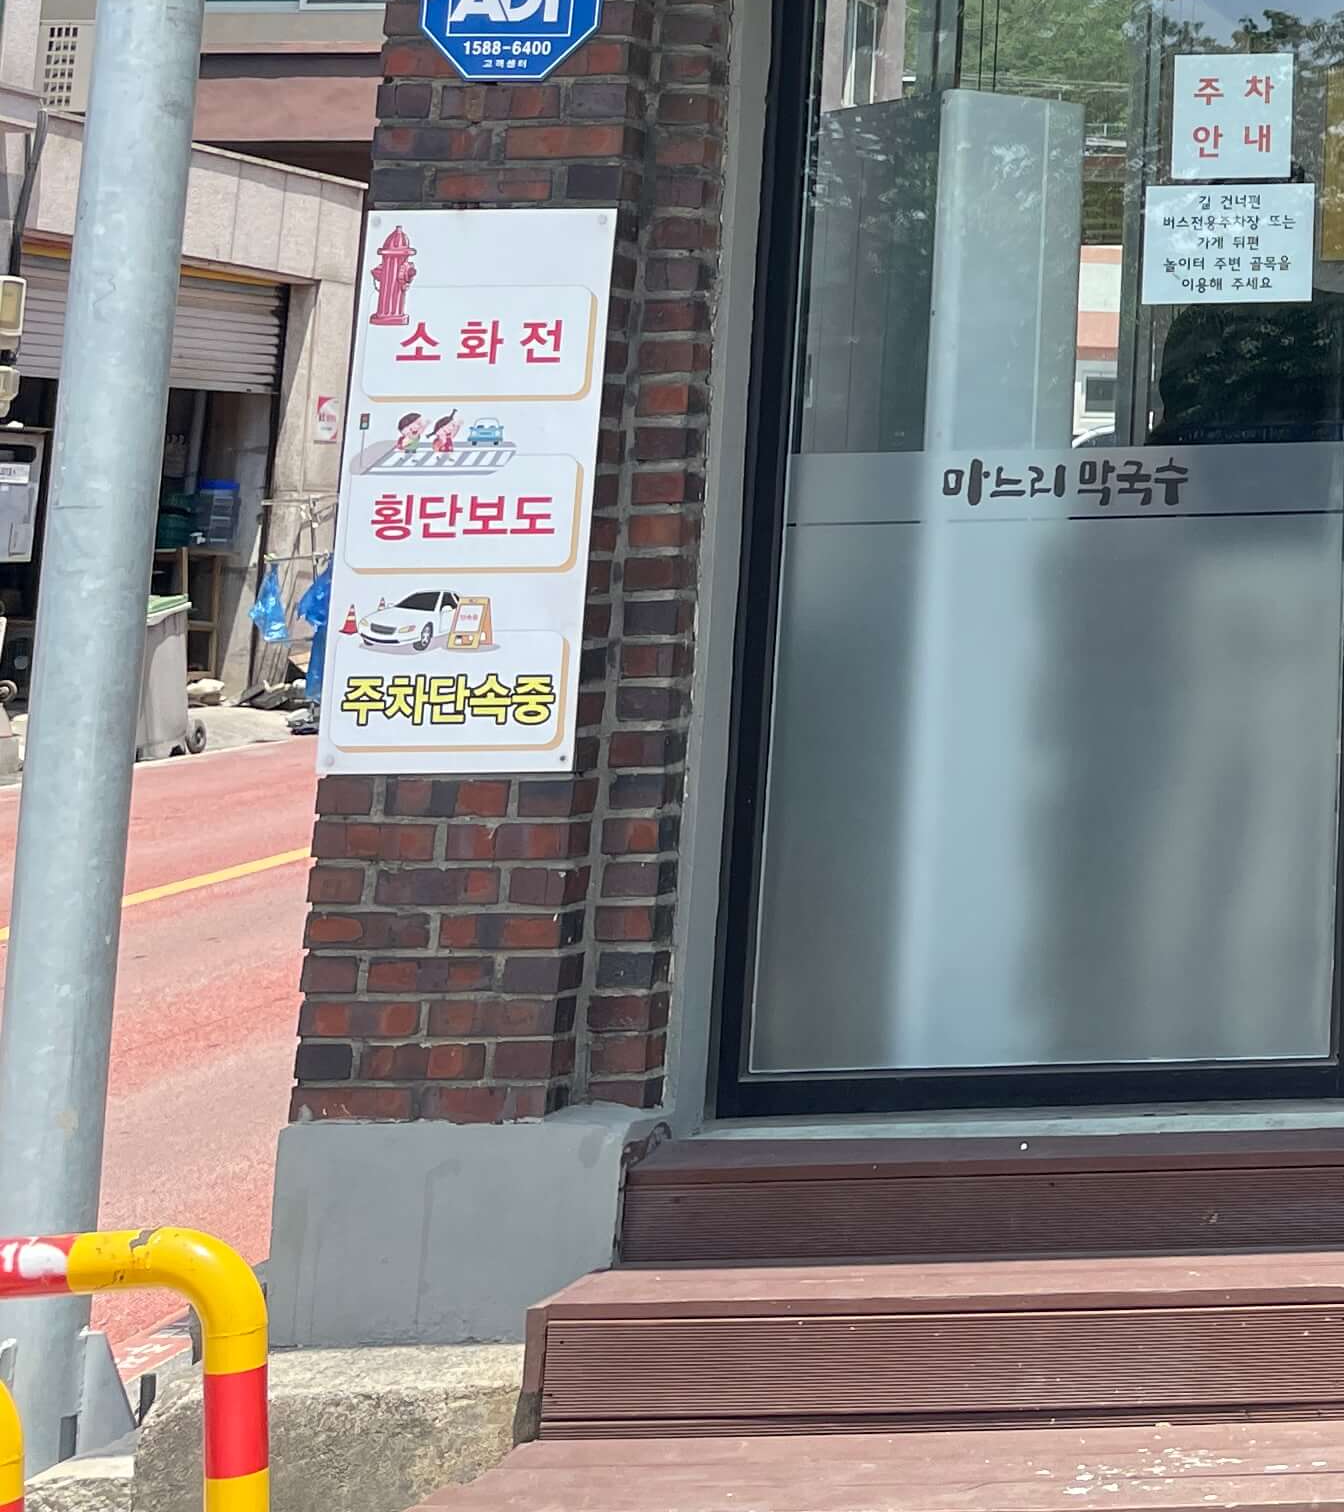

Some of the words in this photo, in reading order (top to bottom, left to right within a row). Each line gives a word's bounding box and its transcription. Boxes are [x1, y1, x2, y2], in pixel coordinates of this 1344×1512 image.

[463, 40, 552, 56] 1588-6400
[1199, 195, 1211, 210] 길
[1220, 194, 1262, 210] 건너편
[1163, 215, 1260, 232] 버스전용주차장
[1268, 215, 1297, 230] 또는
[1197, 236, 1224, 250] 가게
[1233, 236, 1260, 251] 뒤편
[1163, 257, 1206, 273] 놀이터
[1214, 257, 1242, 271] 주변
[1250, 255, 1292, 271] 골목을
[1182, 277, 1224, 294] 이용해
[1231, 277, 1273, 291] 주세요
[942, 458, 1067, 506] 마느리
[1077, 457, 1189, 506] 막국수
[370, 493, 557, 542] 횡단보도
[341, 673, 557, 728] 주차단속중
